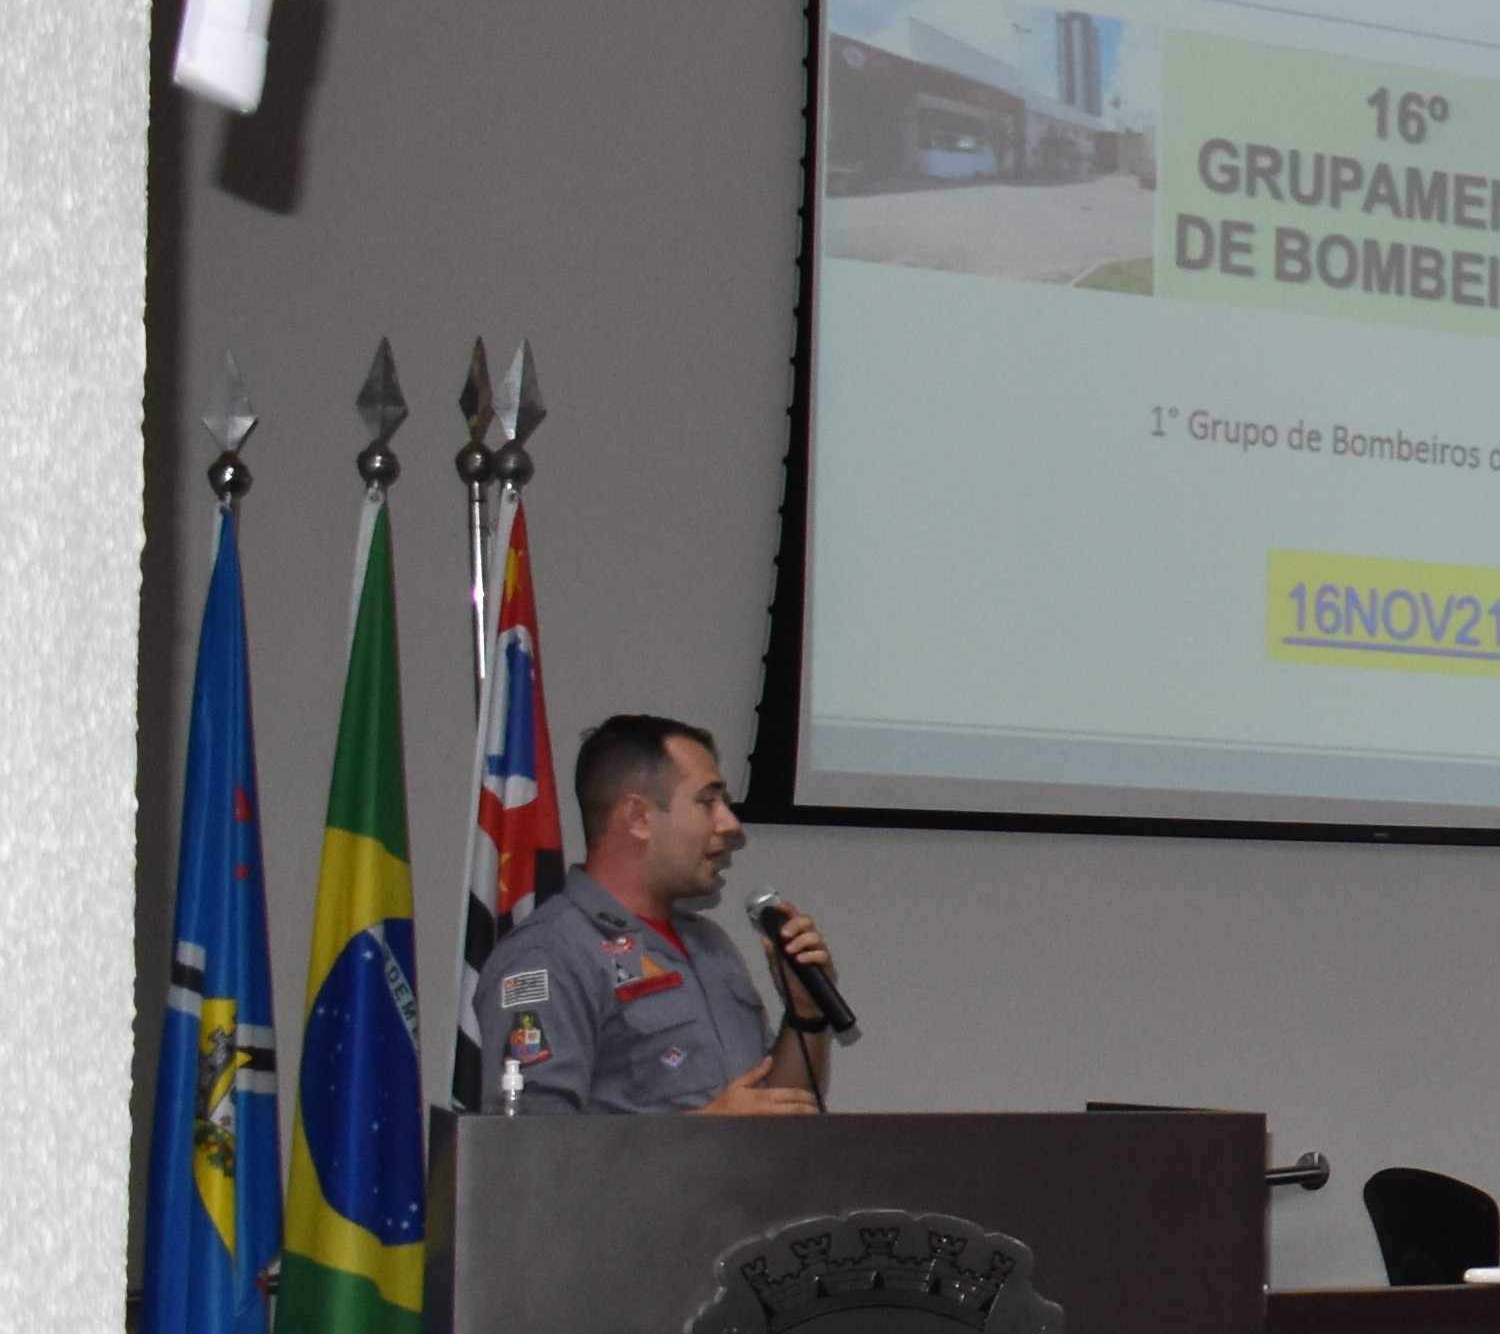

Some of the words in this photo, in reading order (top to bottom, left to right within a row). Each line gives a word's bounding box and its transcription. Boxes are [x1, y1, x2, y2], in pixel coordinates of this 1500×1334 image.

[1174, 213, 1256, 279] DE
[1187, 409, 1279, 454] Grupo
[1287, 418, 1323, 455] de
[1332, 424, 1481, 473] Bombeiros
